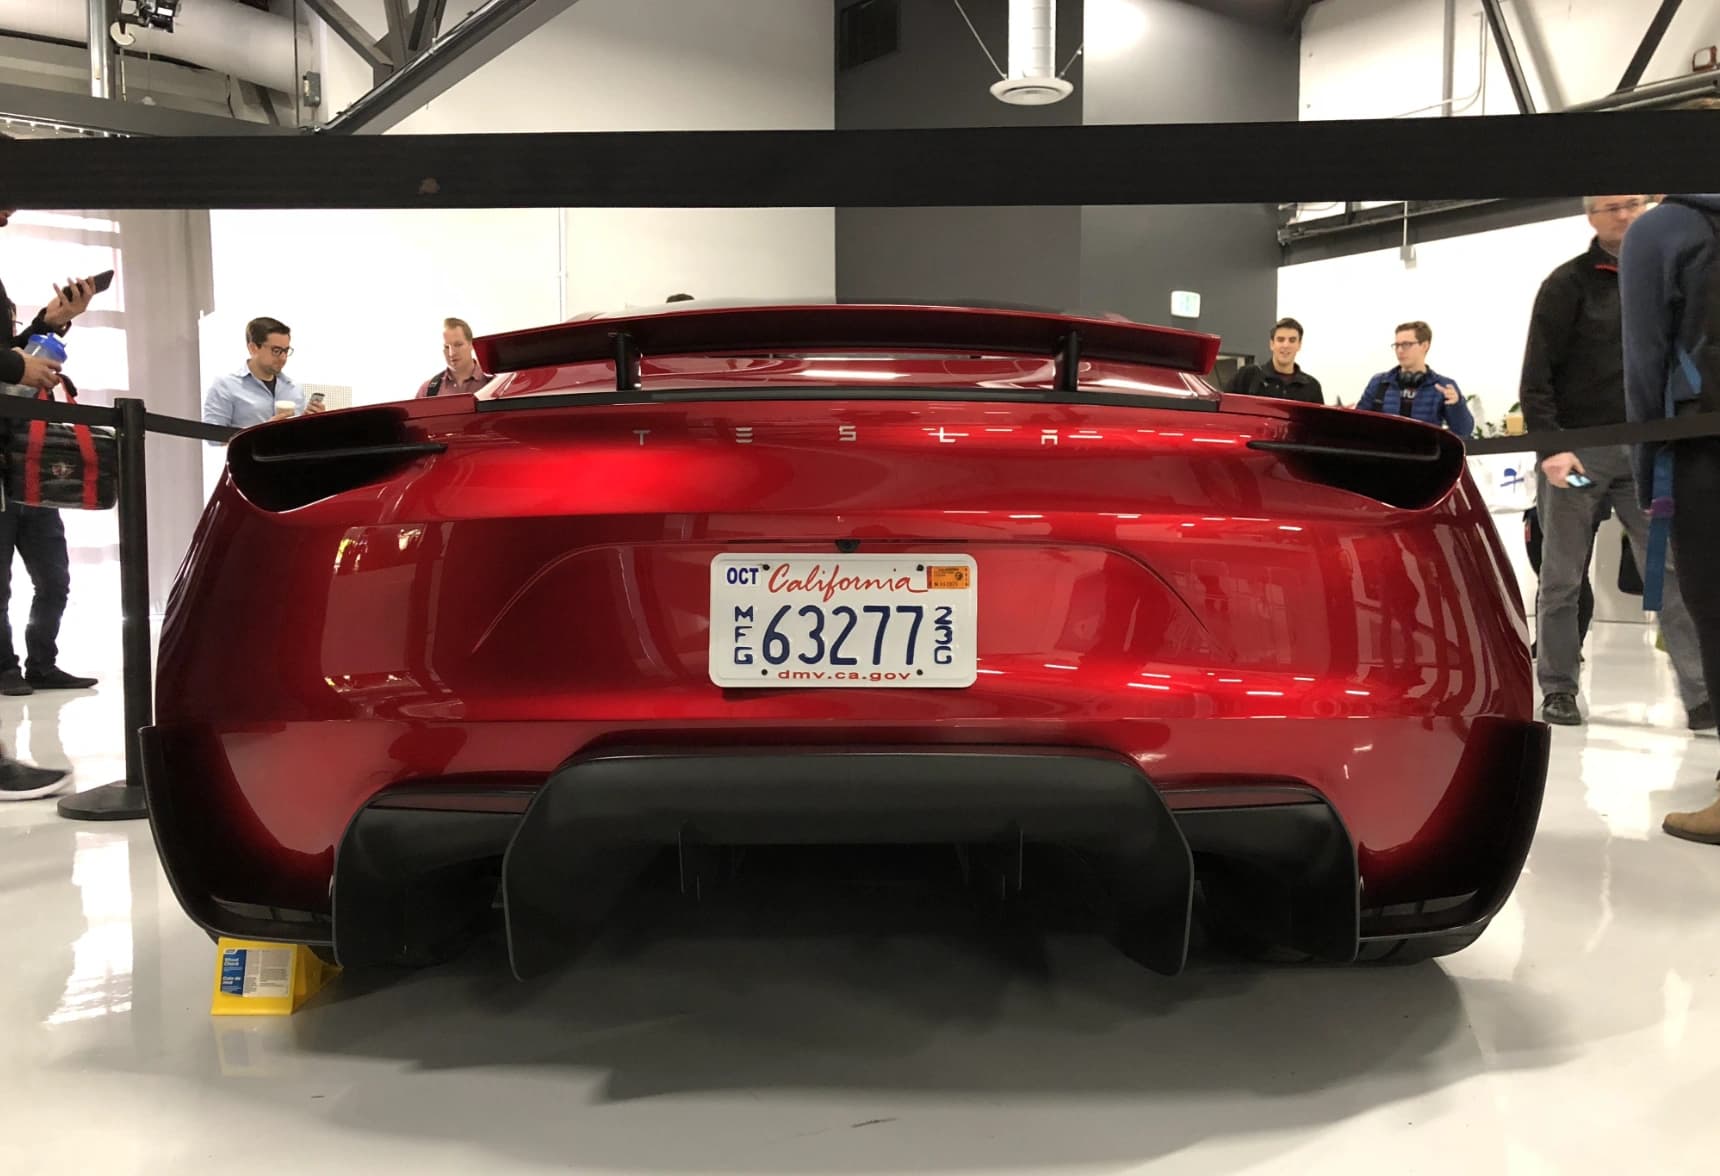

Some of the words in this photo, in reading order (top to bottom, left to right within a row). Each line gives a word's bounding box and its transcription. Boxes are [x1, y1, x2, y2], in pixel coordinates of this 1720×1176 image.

[632, 425, 1058, 446] TESLA
[726, 567, 759, 585] OCT
[768, 563, 928, 602] California
[734, 605, 754, 665] MFG
[762, 604, 924, 665] 63277
[777, 669, 912, 682] dmv.ca.gov
